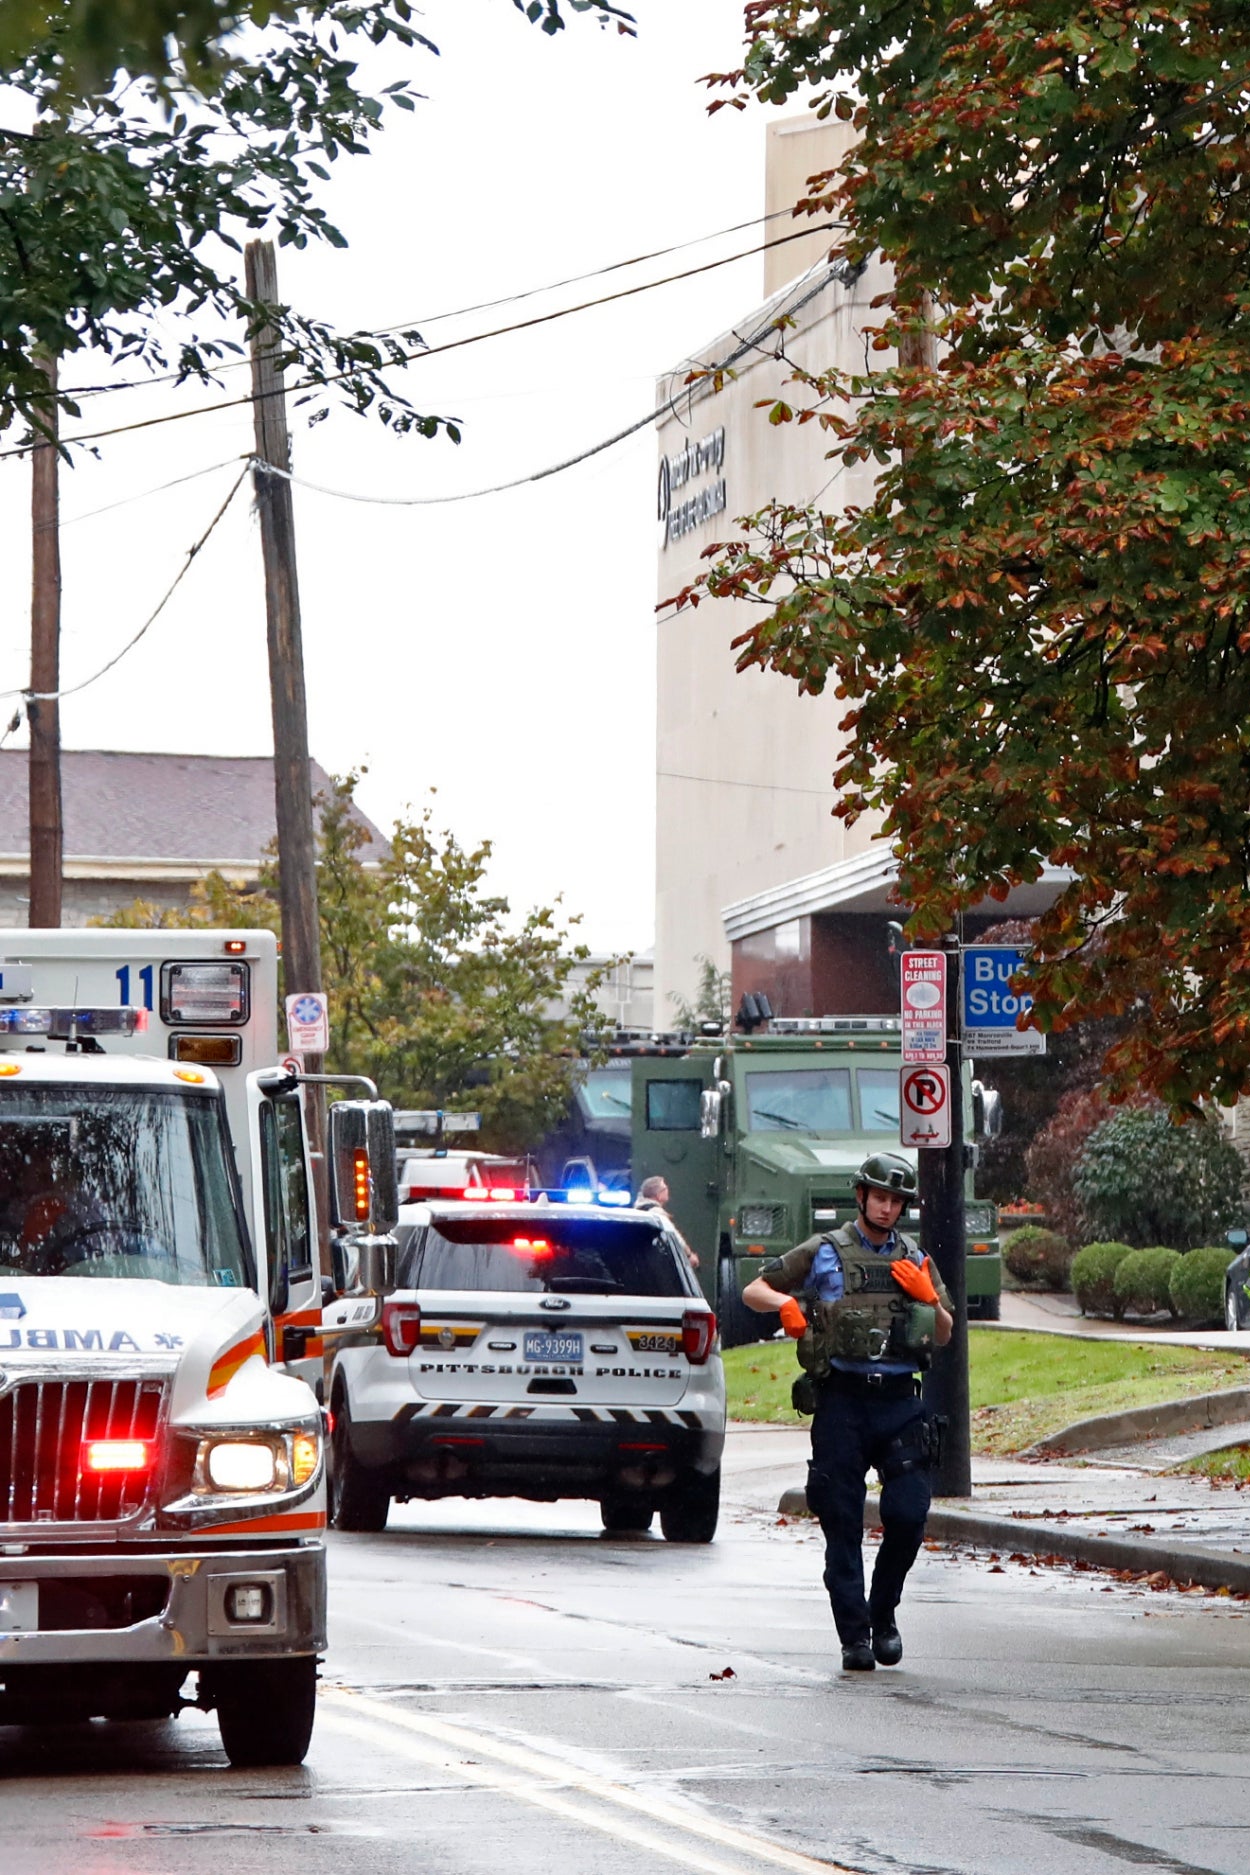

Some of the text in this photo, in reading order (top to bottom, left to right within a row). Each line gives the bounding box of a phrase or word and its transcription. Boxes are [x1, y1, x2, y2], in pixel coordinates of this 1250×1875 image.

[908, 957, 938, 969] STREET
[904, 970, 942, 982] CLEANING
[116, 964, 153, 1012] 11
[904, 1009, 943, 1020] NO PARKING
[526, 1339, 581, 1355] MG-9399H
[639, 1334, 676, 1351] 3424
[420, 1363, 682, 1379] PITTSBURGH POLICE
